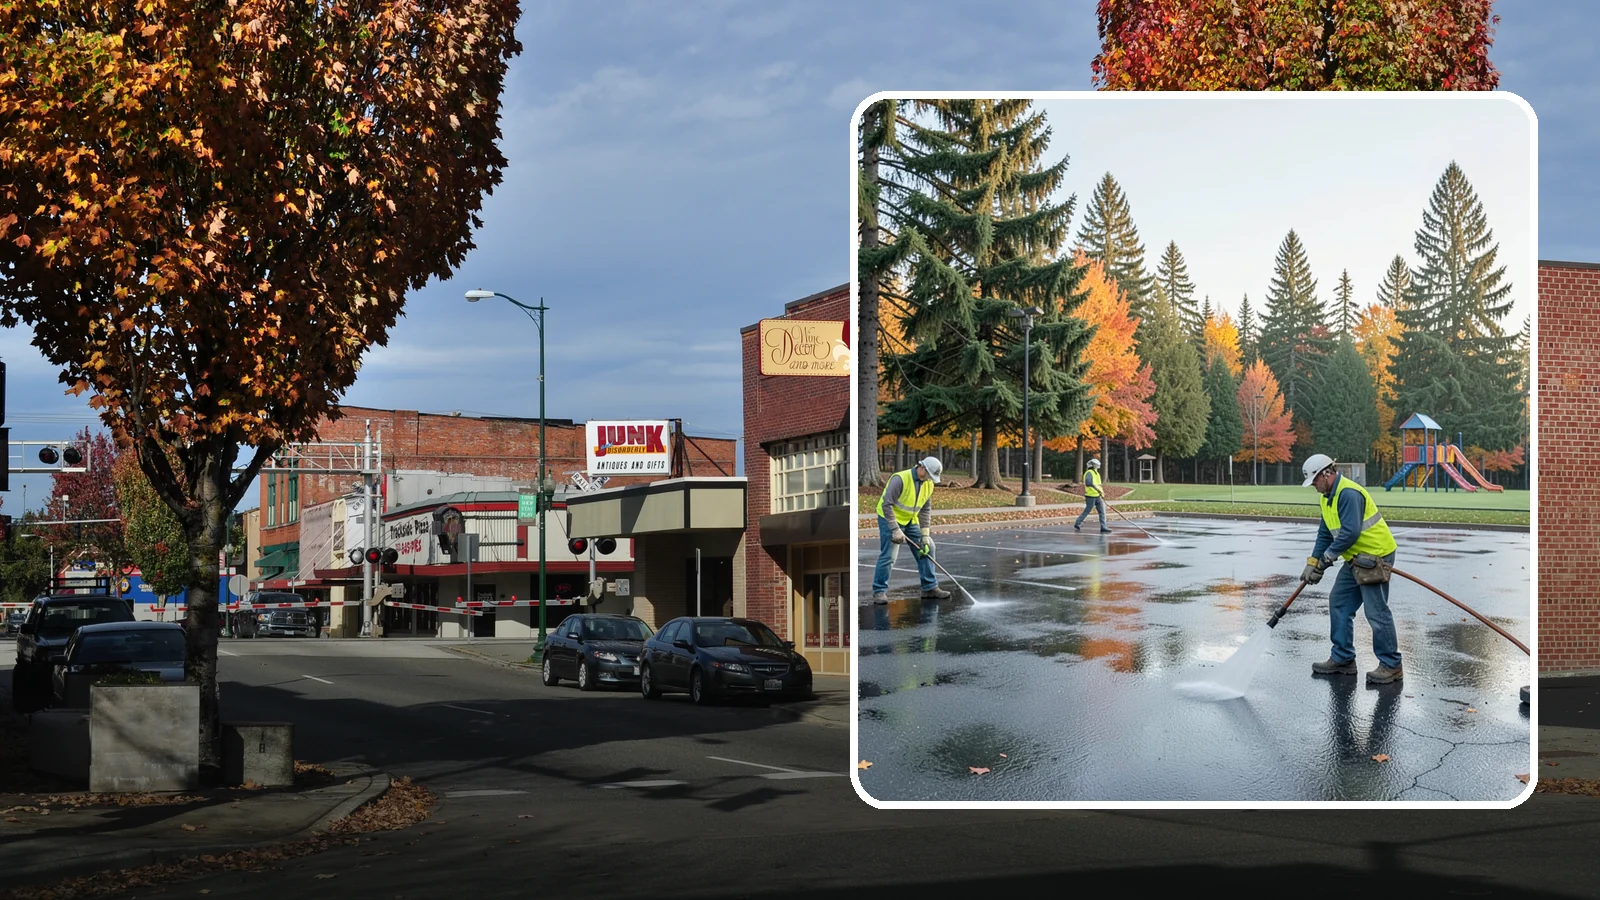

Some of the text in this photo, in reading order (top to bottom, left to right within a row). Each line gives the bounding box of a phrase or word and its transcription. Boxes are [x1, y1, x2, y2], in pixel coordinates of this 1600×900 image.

[765, 327, 830, 366] Decor
[595, 425, 665, 457] JUNK
[607, 446, 646, 454] DISORDERLY
[596, 460, 665, 470] ANTIQUES AND GIFTS
[573, 473, 589, 492] RAIL
[390, 519, 429, 539] Trackside Pizza
